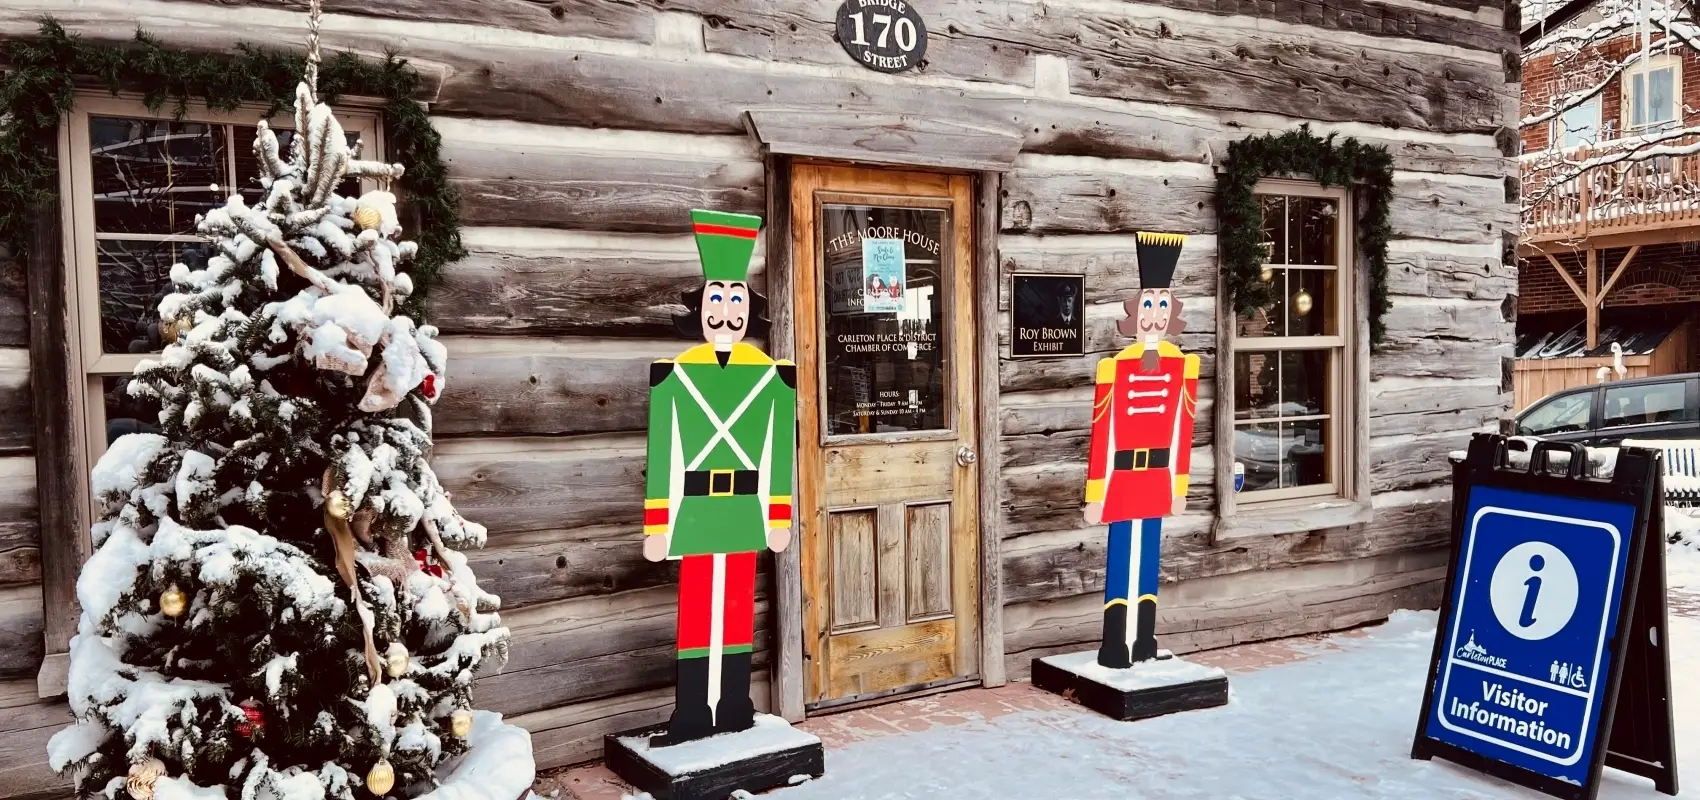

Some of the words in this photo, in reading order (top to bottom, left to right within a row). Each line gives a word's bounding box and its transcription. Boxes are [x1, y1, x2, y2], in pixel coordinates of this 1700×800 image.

[858, 0, 906, 14] BRIDGE
[848, 12, 917, 52] 170
[863, 50, 908, 69] STREET
[829, 231, 855, 252] THE
[857, 226, 899, 242] MOORE
[903, 229, 940, 255] HOUSE
[837, 334, 875, 343] CARLETON
[877, 333, 897, 342] PLACE
[898, 334, 904, 342] &
[905, 333, 936, 342] DISTRICT
[845, 343, 880, 353] CHAMBER
[881, 343, 891, 352] OF
[892, 343, 932, 352] COMERCE
[1482, 680, 1549, 717] Visitor
[1450, 696, 1571, 750] Information
